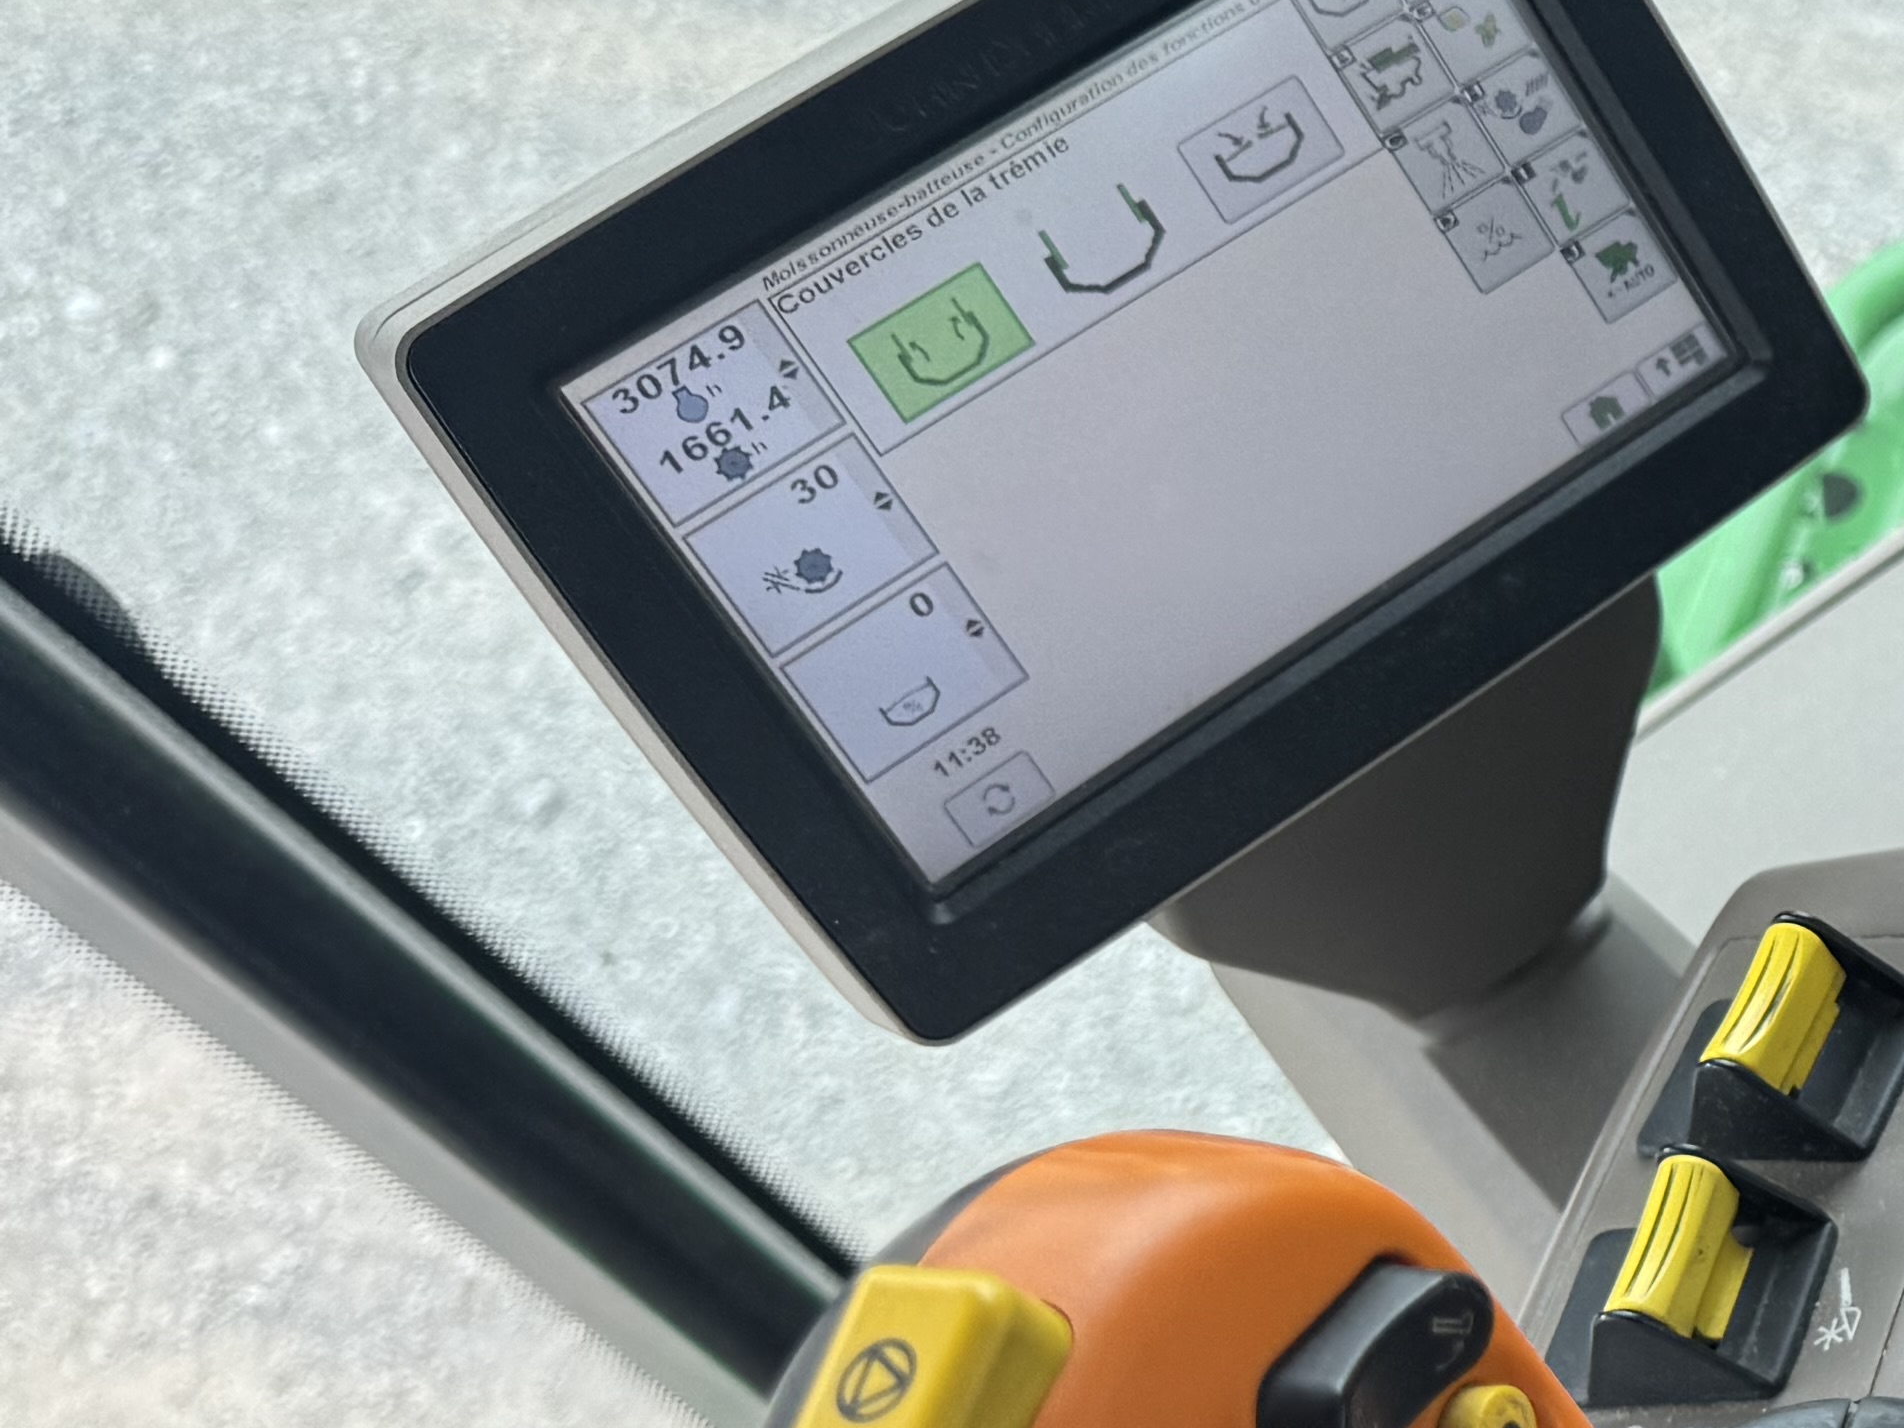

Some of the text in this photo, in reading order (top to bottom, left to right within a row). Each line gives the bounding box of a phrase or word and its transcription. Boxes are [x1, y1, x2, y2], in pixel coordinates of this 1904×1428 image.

[761, 154, 985, 292] Moissonneuse-batteuse
[1000, 72, 1126, 151] Configuration
[1126, 54, 1159, 78] des
[1163, 2, 1246, 55] fonctions
[776, 136, 1070, 314] Couvercles de la trémie
[612, 325, 745, 414] 3074.9
[659, 385, 791, 475] 1661.4
[790, 464, 839, 505] 30
[908, 591, 935, 617] 0
[932, 725, 1002, 779] 11:38
